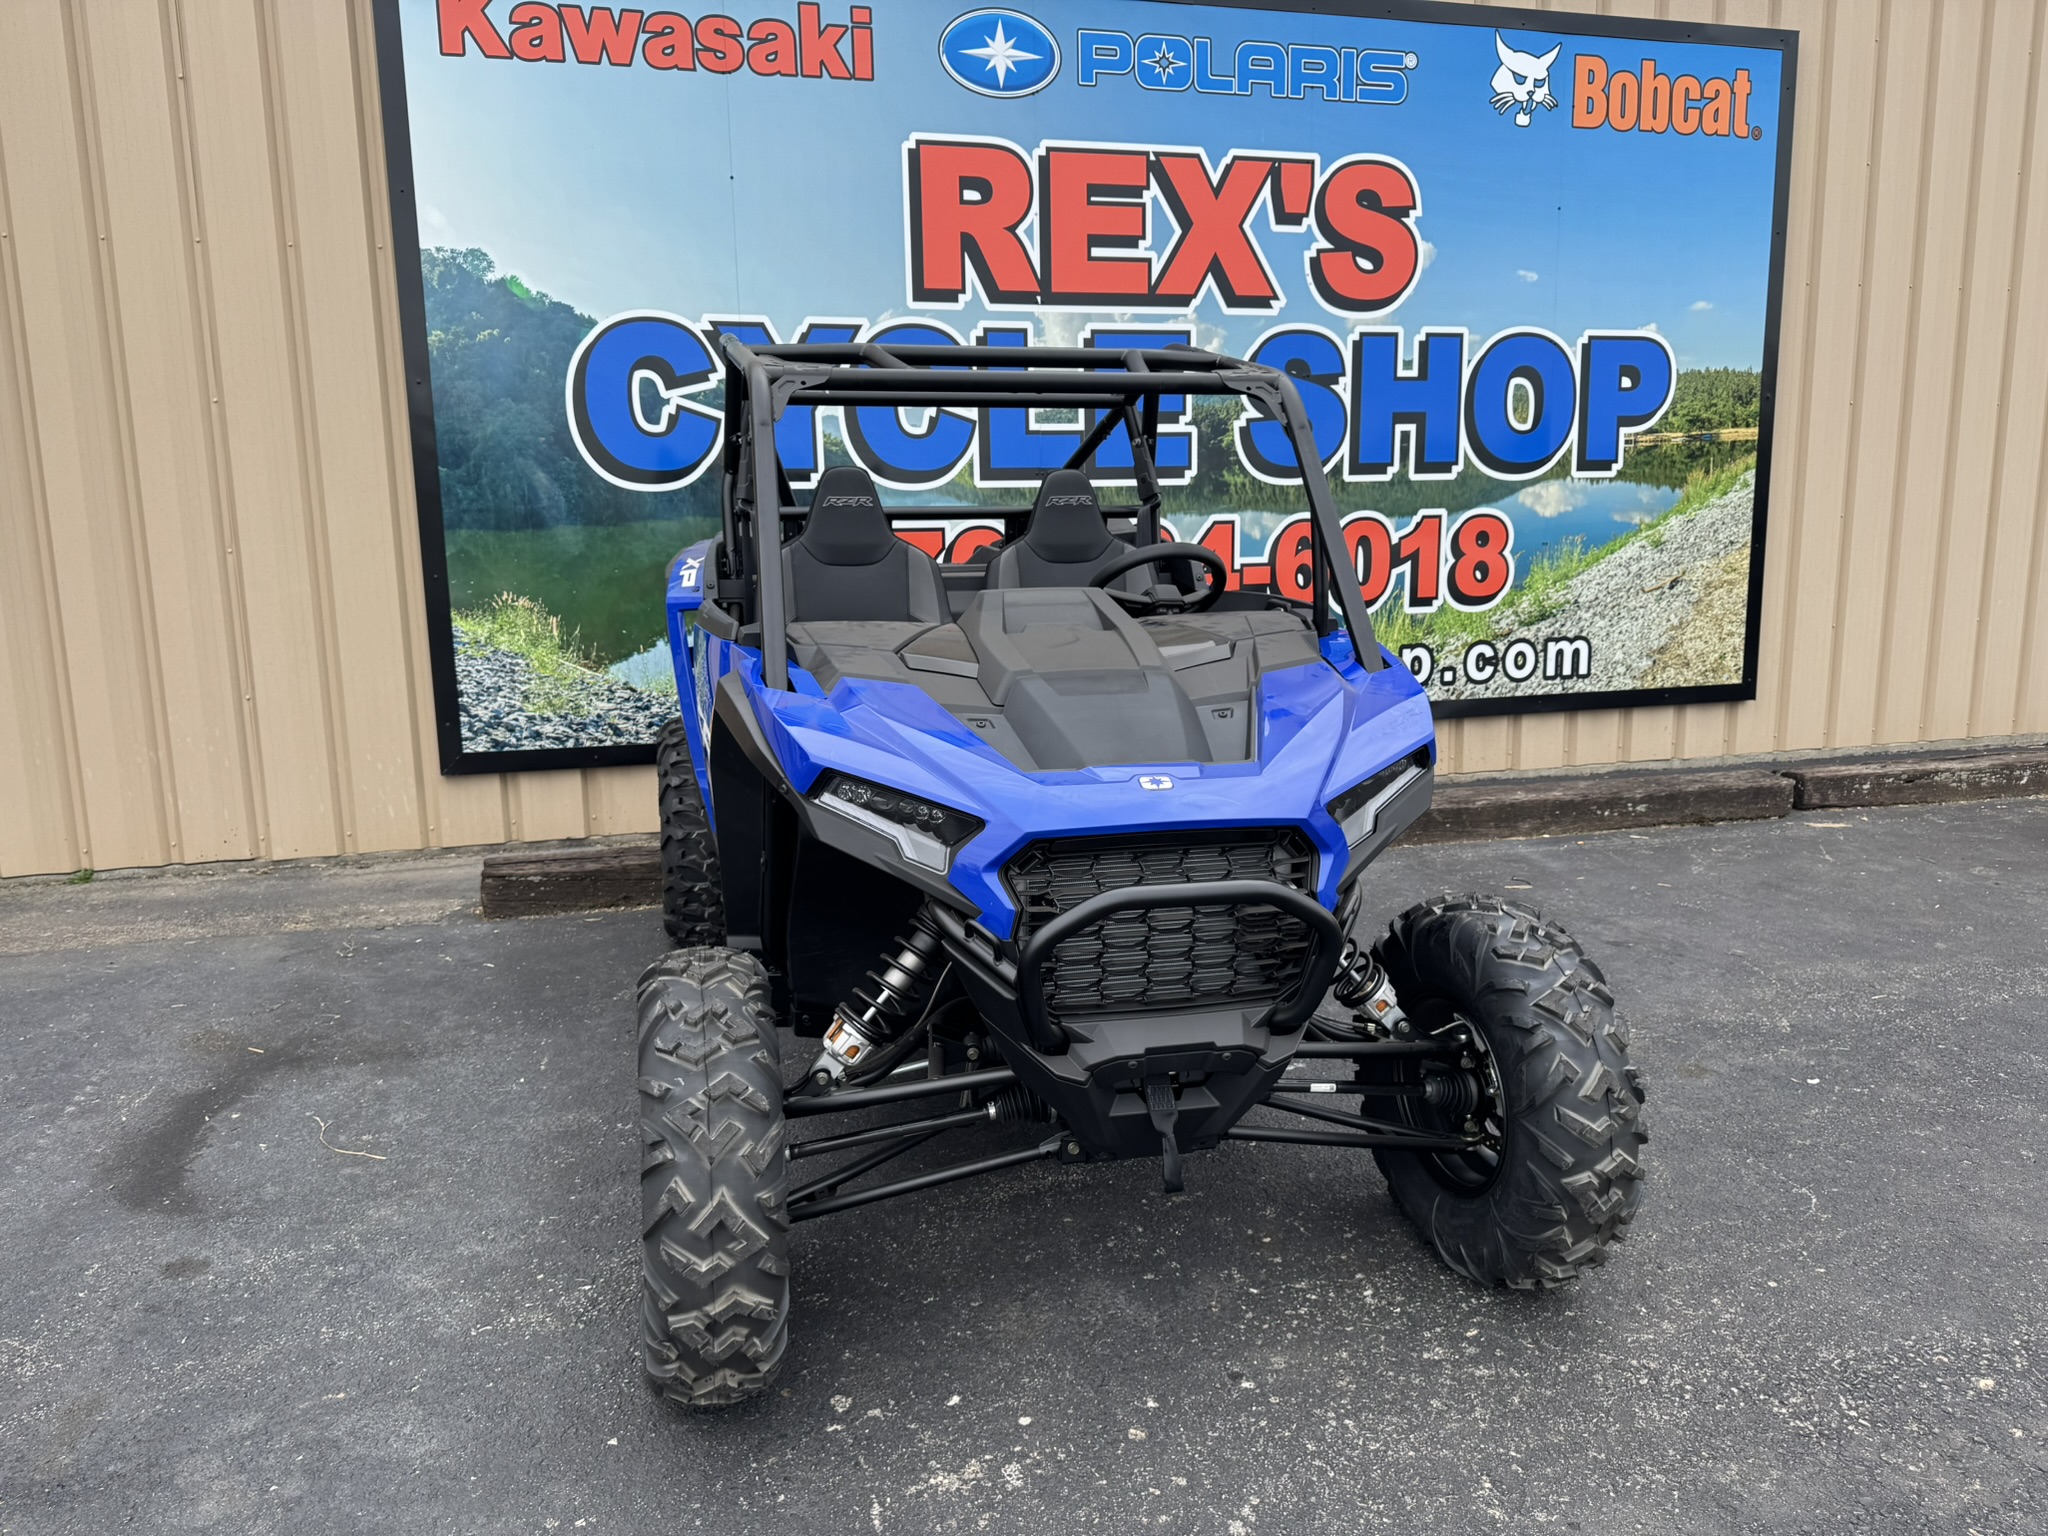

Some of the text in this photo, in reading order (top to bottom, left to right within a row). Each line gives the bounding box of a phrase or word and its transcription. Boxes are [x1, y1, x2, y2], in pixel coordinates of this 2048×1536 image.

[436, 0, 875, 81] Kawasaki
[902, 132, 1422, 318] REX'S
[1233, 322, 1678, 486] SHOP
[822, 496, 874, 507] RZR
[1045, 495, 1093, 507] RZR
